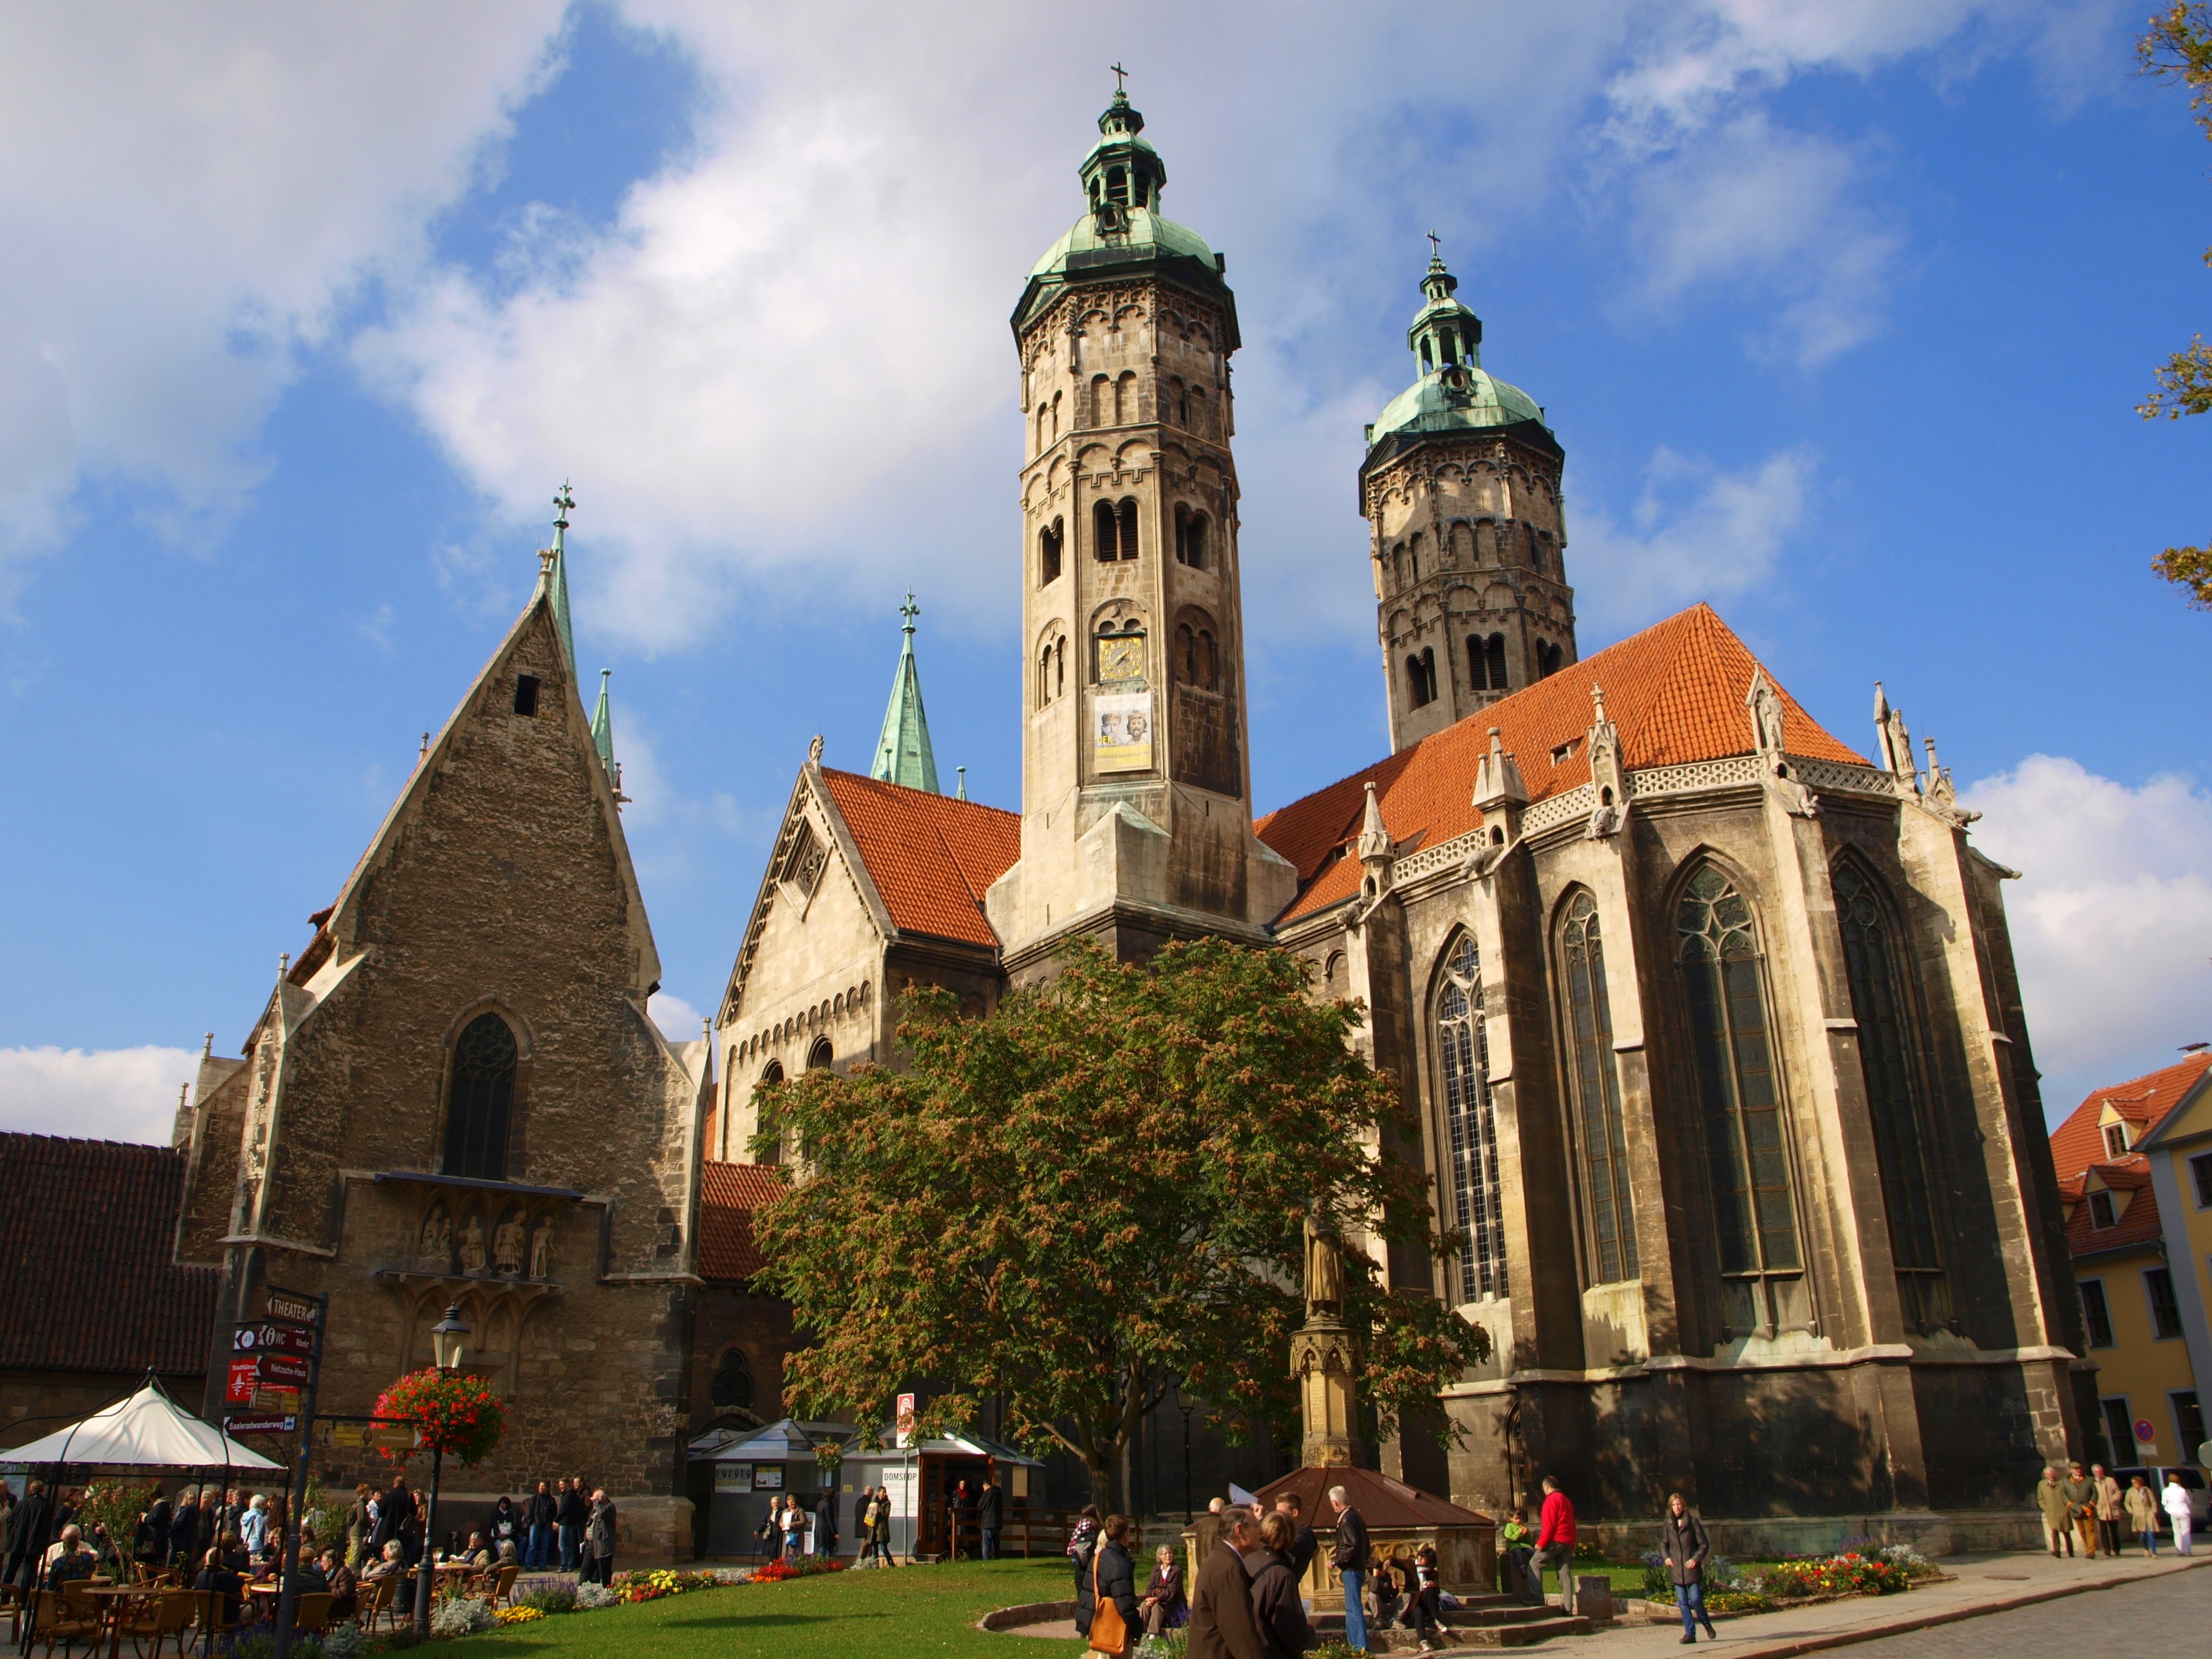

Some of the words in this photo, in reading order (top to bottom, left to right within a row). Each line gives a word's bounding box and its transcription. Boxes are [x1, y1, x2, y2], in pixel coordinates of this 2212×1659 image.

[274, 1299, 307, 1321] THEATER
[275, 1332, 286, 1345] WC
[295, 1338, 309, 1349] Markt
[270, 1363, 307, 1377] Nietzsche-Haus
[229, 1421, 284, 1430] Saaleradwanderweg
